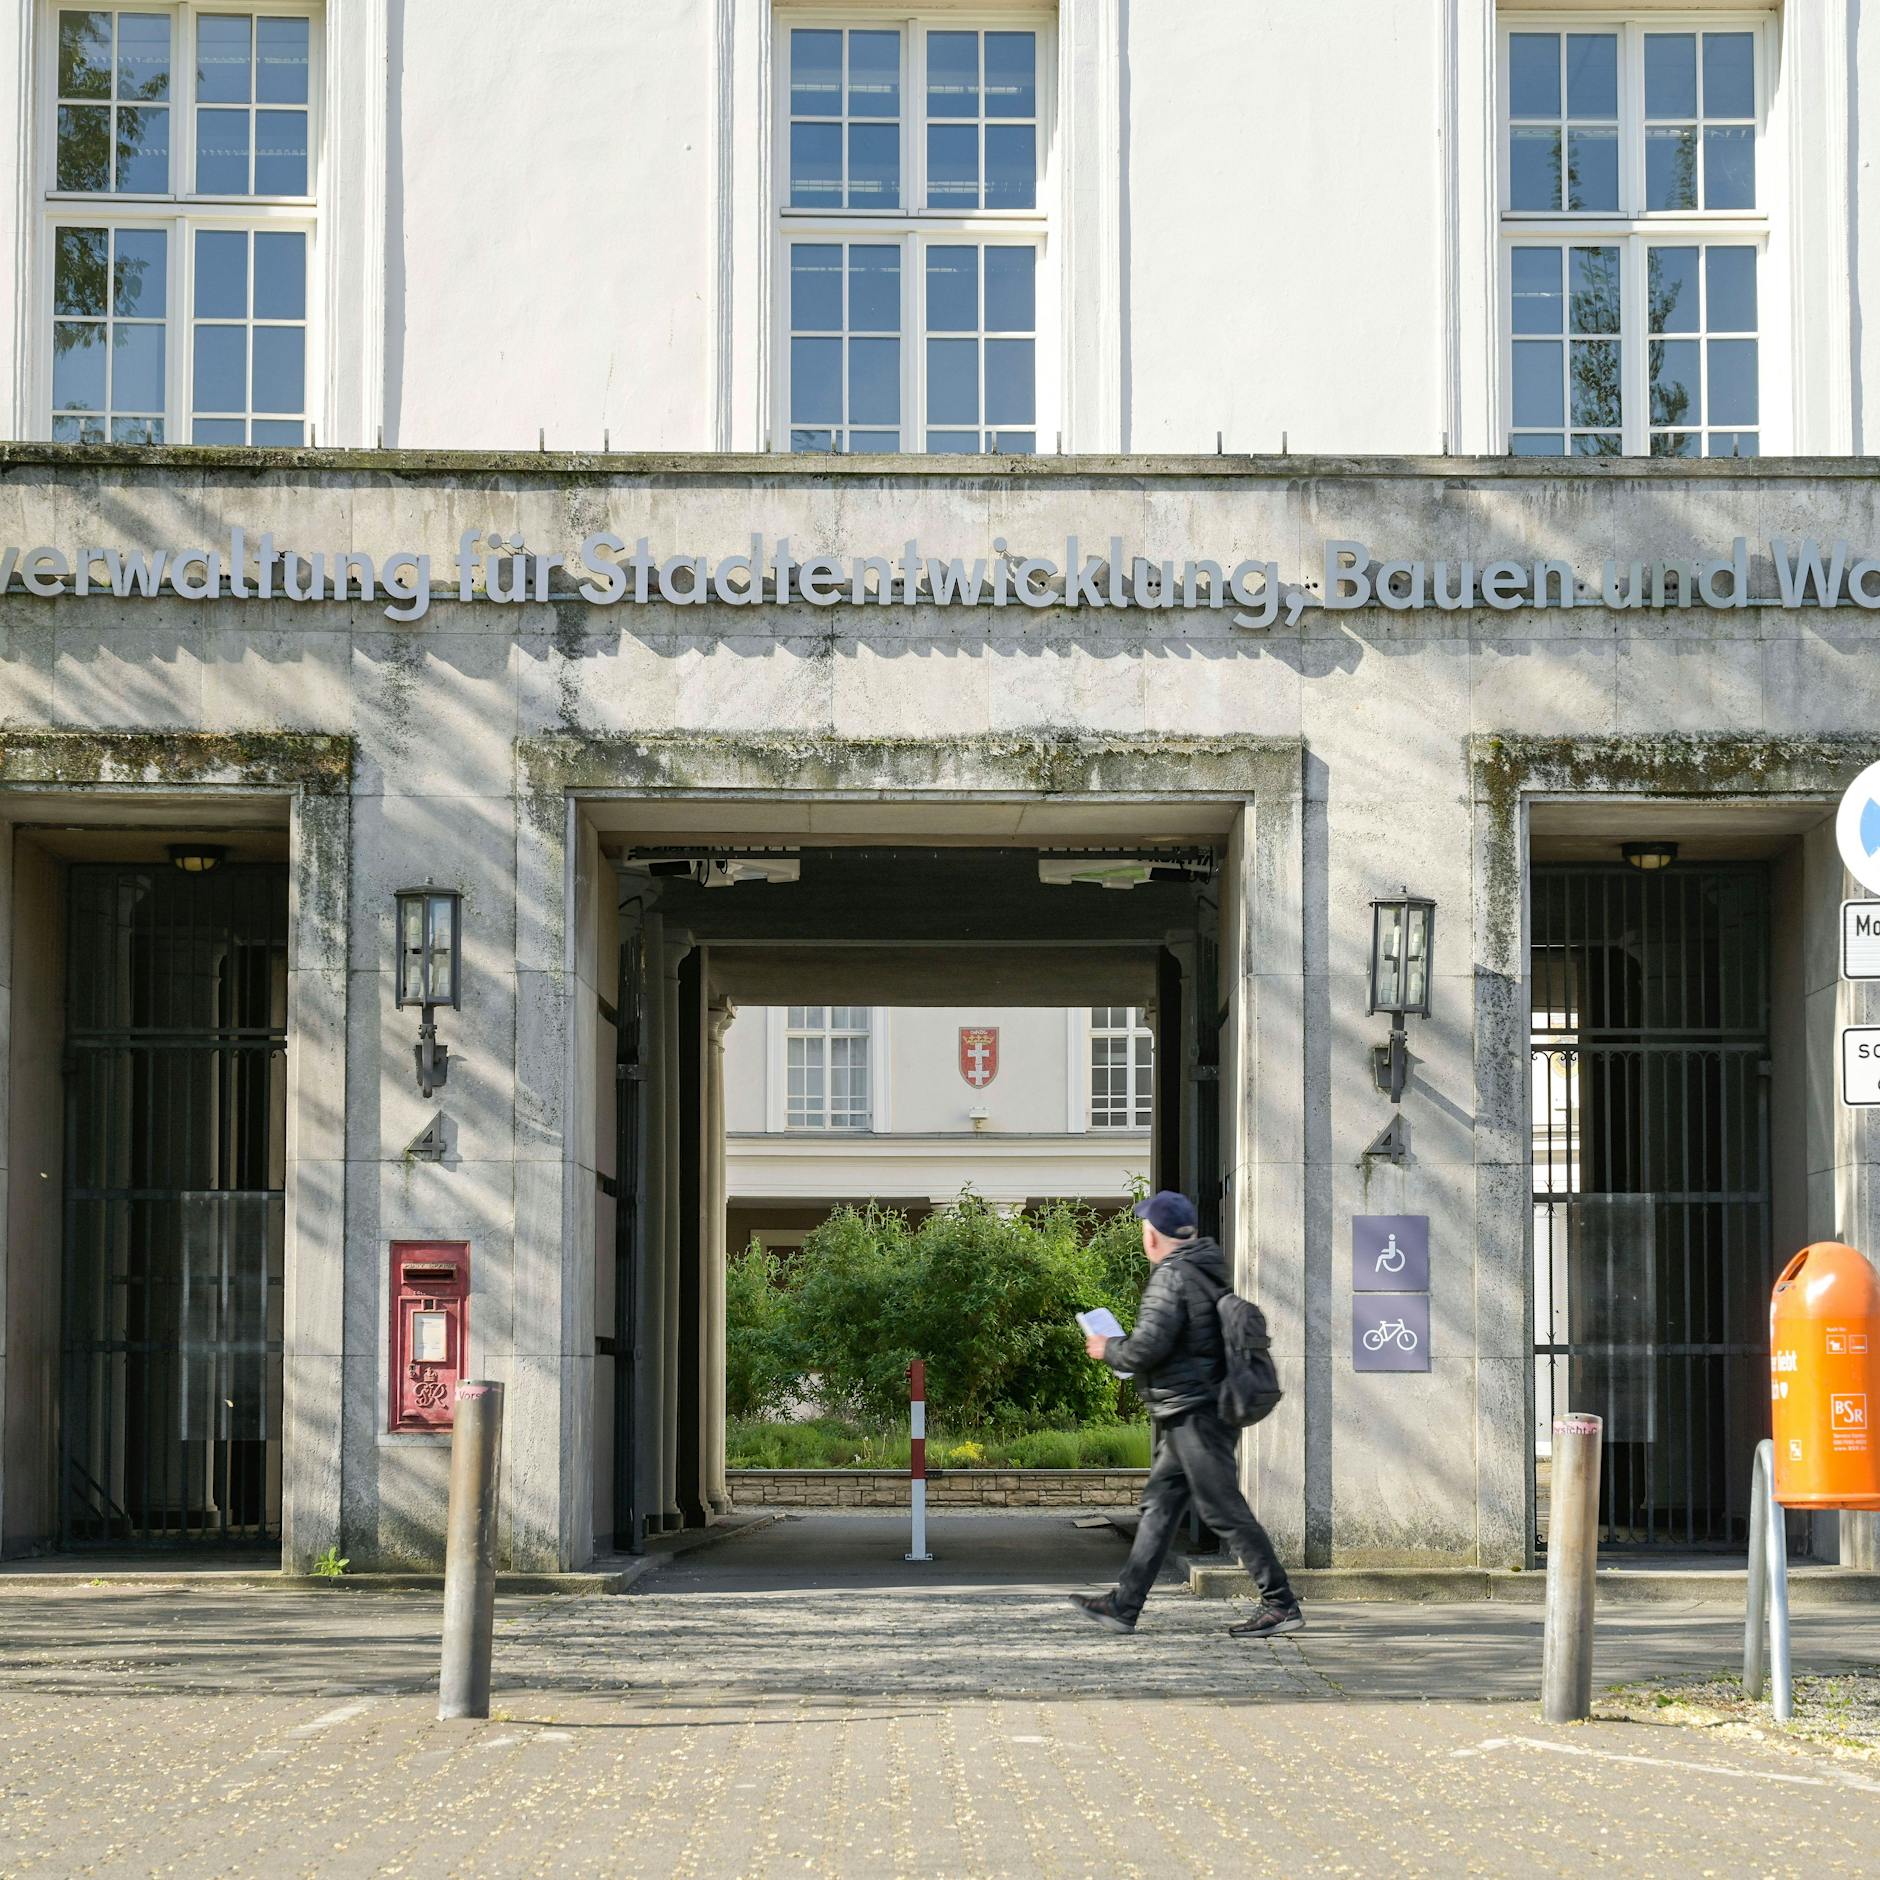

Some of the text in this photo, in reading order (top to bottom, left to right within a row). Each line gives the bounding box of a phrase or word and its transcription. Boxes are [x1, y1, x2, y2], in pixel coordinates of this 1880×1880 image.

[455, 528, 565, 604] für
[579, 532, 1304, 629] Stadtentwicklung,
[1324, 539, 1574, 610] Bauen
[1602, 537, 1748, 610] und
[407, 1110, 446, 1161] 4
[1364, 1113, 1405, 1164] 4
[1835, 1400, 1864, 1423] BSR
